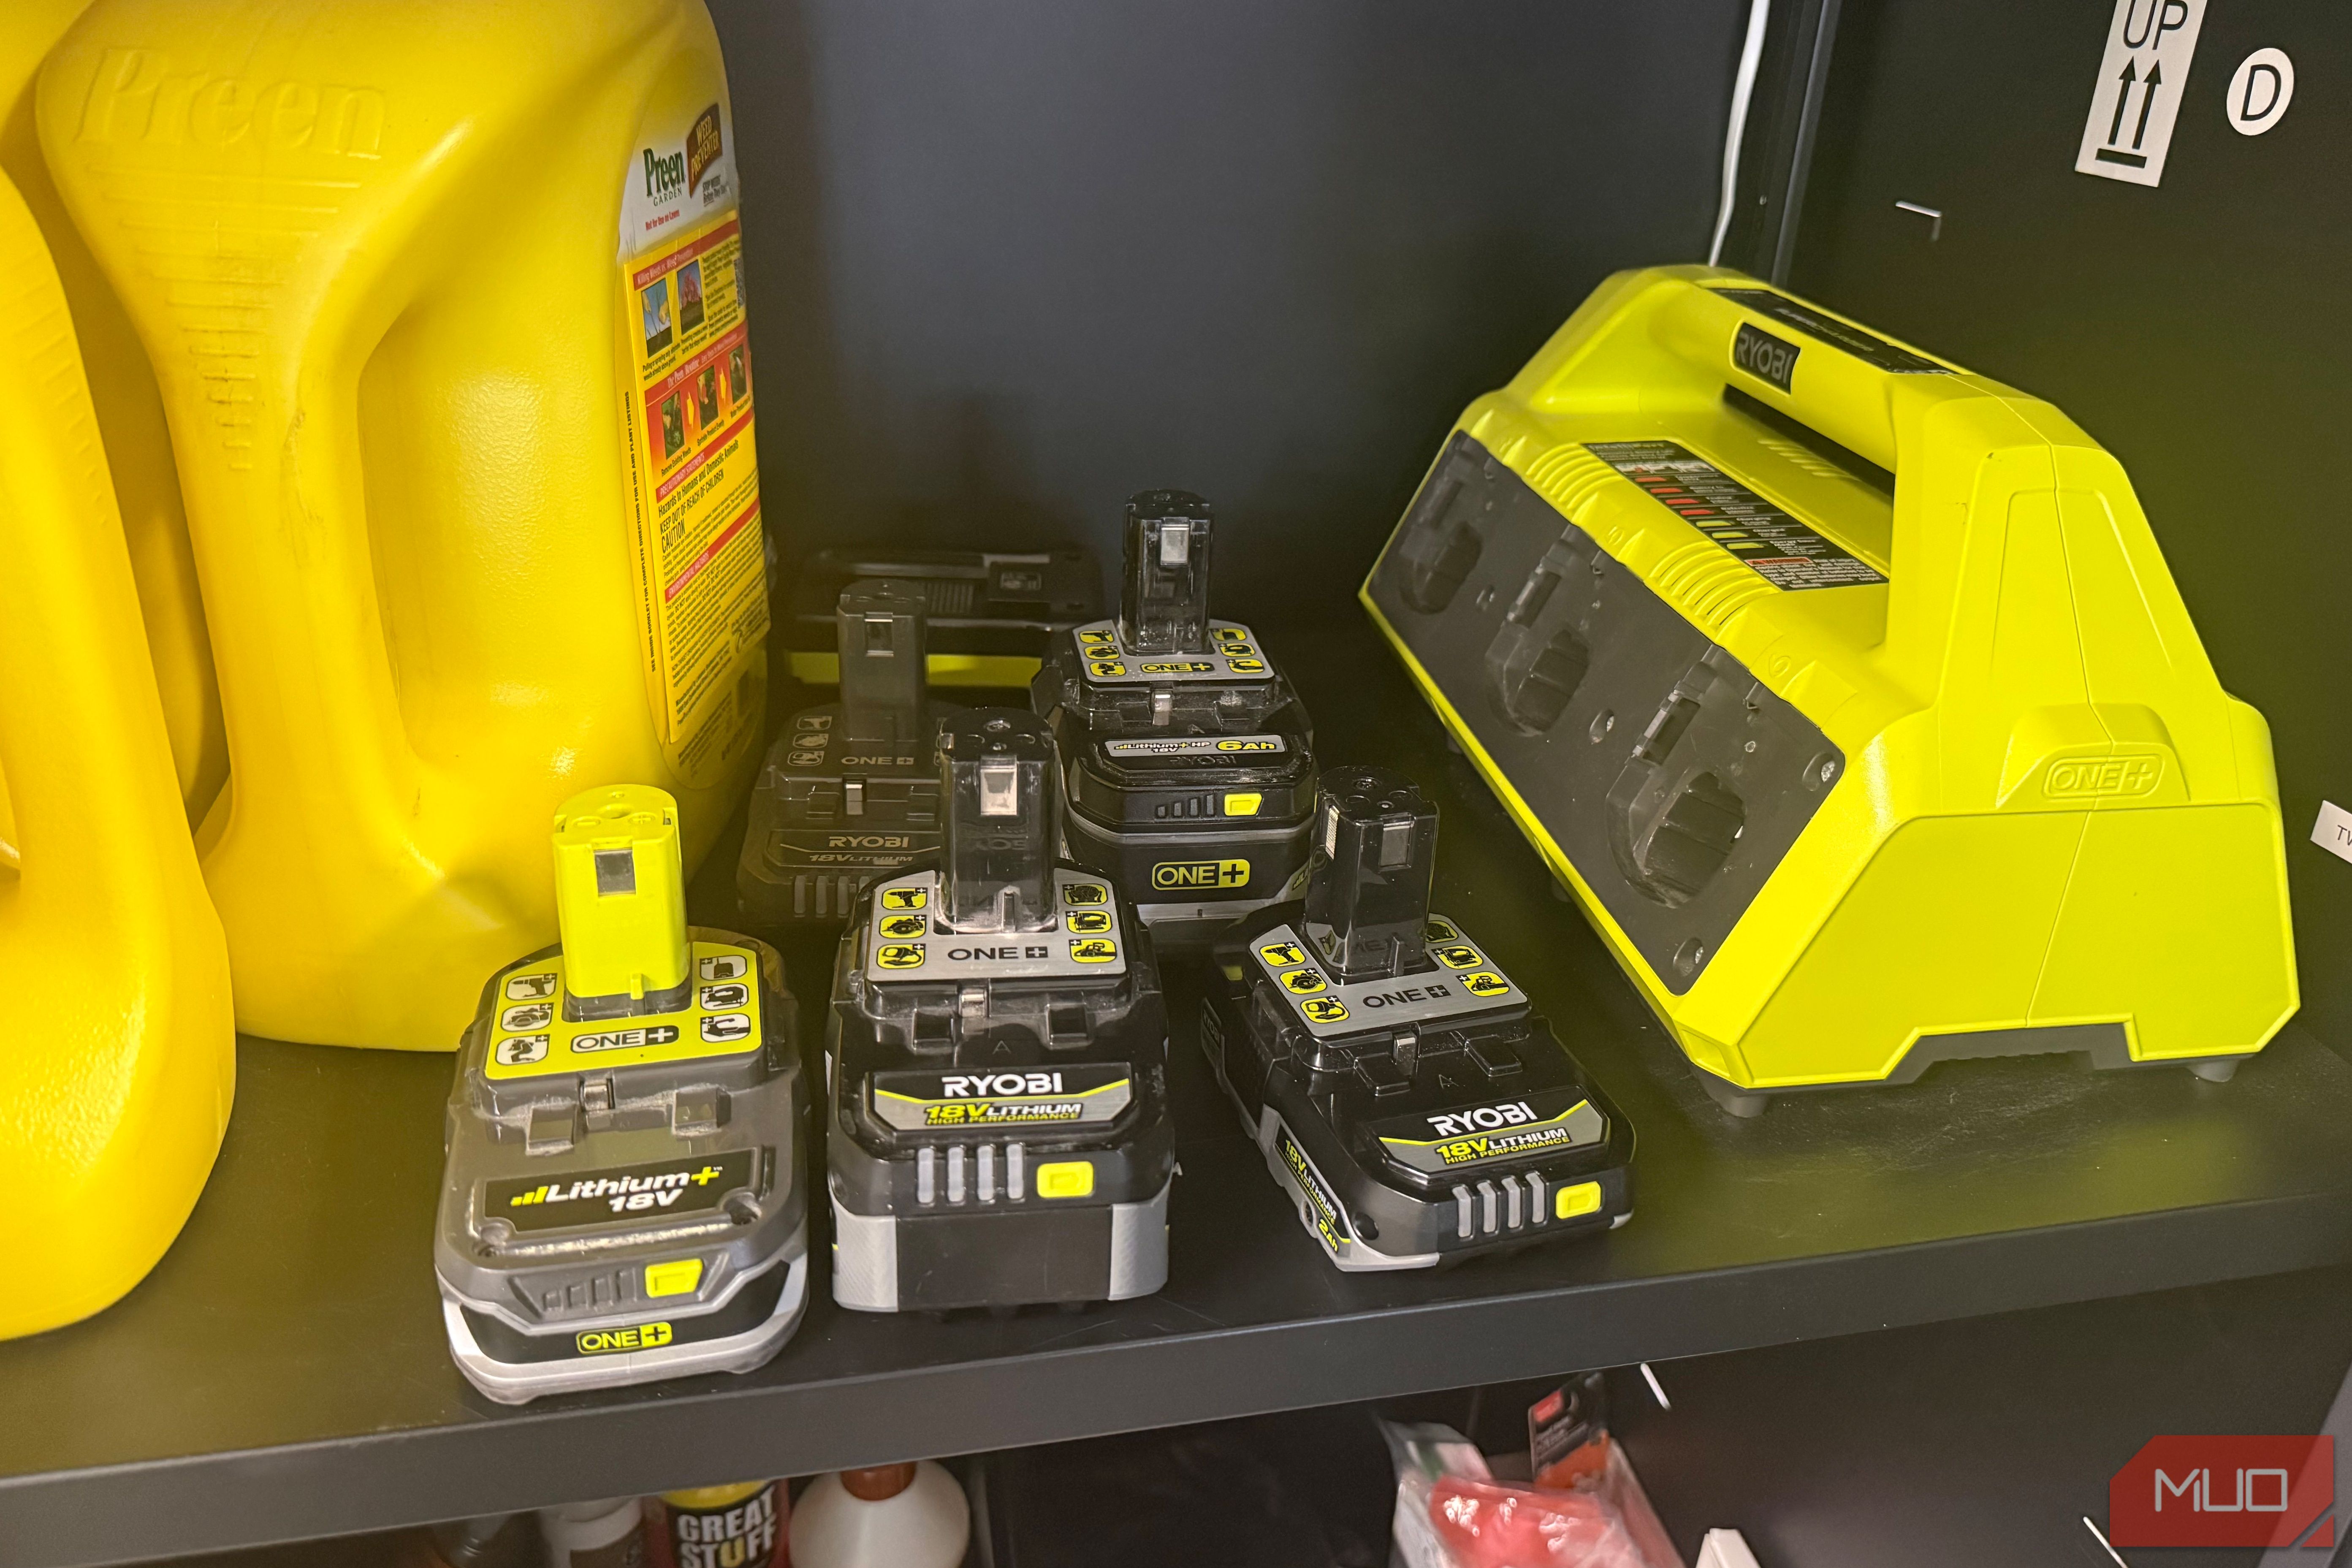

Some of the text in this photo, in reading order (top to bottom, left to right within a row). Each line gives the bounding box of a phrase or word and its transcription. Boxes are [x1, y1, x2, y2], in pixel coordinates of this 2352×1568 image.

[2123, 0, 2189, 50] UP
[74, 47, 387, 160] Preen
[2240, 63, 2282, 121] D
[696, 116, 713, 145] WEED
[691, 130, 720, 180] PREVENTER
[643, 148, 686, 198] Preen
[653, 187, 682, 206] GARDEN
[1734, 332, 1793, 384] RYOBI
[659, 439, 739, 518] Hazards to Humans and Domestic Animals
[660, 468, 724, 535] KEEP OUT OF REACH OF CHILDREN
[662, 518, 686, 554] CAUTION
[1216, 740, 1276, 751] 6Ah
[809, 854, 851, 862] 18V
[829, 836, 909, 848] RYOBI
[941, 1072, 1063, 1098] RYOBI
[926, 1103, 1082, 1119] 18V LITHIUM
[927, 1113, 1080, 1125] HIGH PERFORMANCE
[1426, 1101, 1538, 1136] RYOBI
[1436, 1128, 1568, 1158] 18V LITHIUM
[1445, 1136, 1570, 1164] HIGH PERFORMANCE
[1285, 1139, 1337, 1220] 18V LITHIUM
[1297, 1169, 1336, 1225] PERFORMANCE
[608, 1188, 683, 1213] 18V
[1318, 1218, 1339, 1253] 2Ah
[678, 1485, 776, 1542] GREAT
[680, 1512, 777, 1568] STUFF
